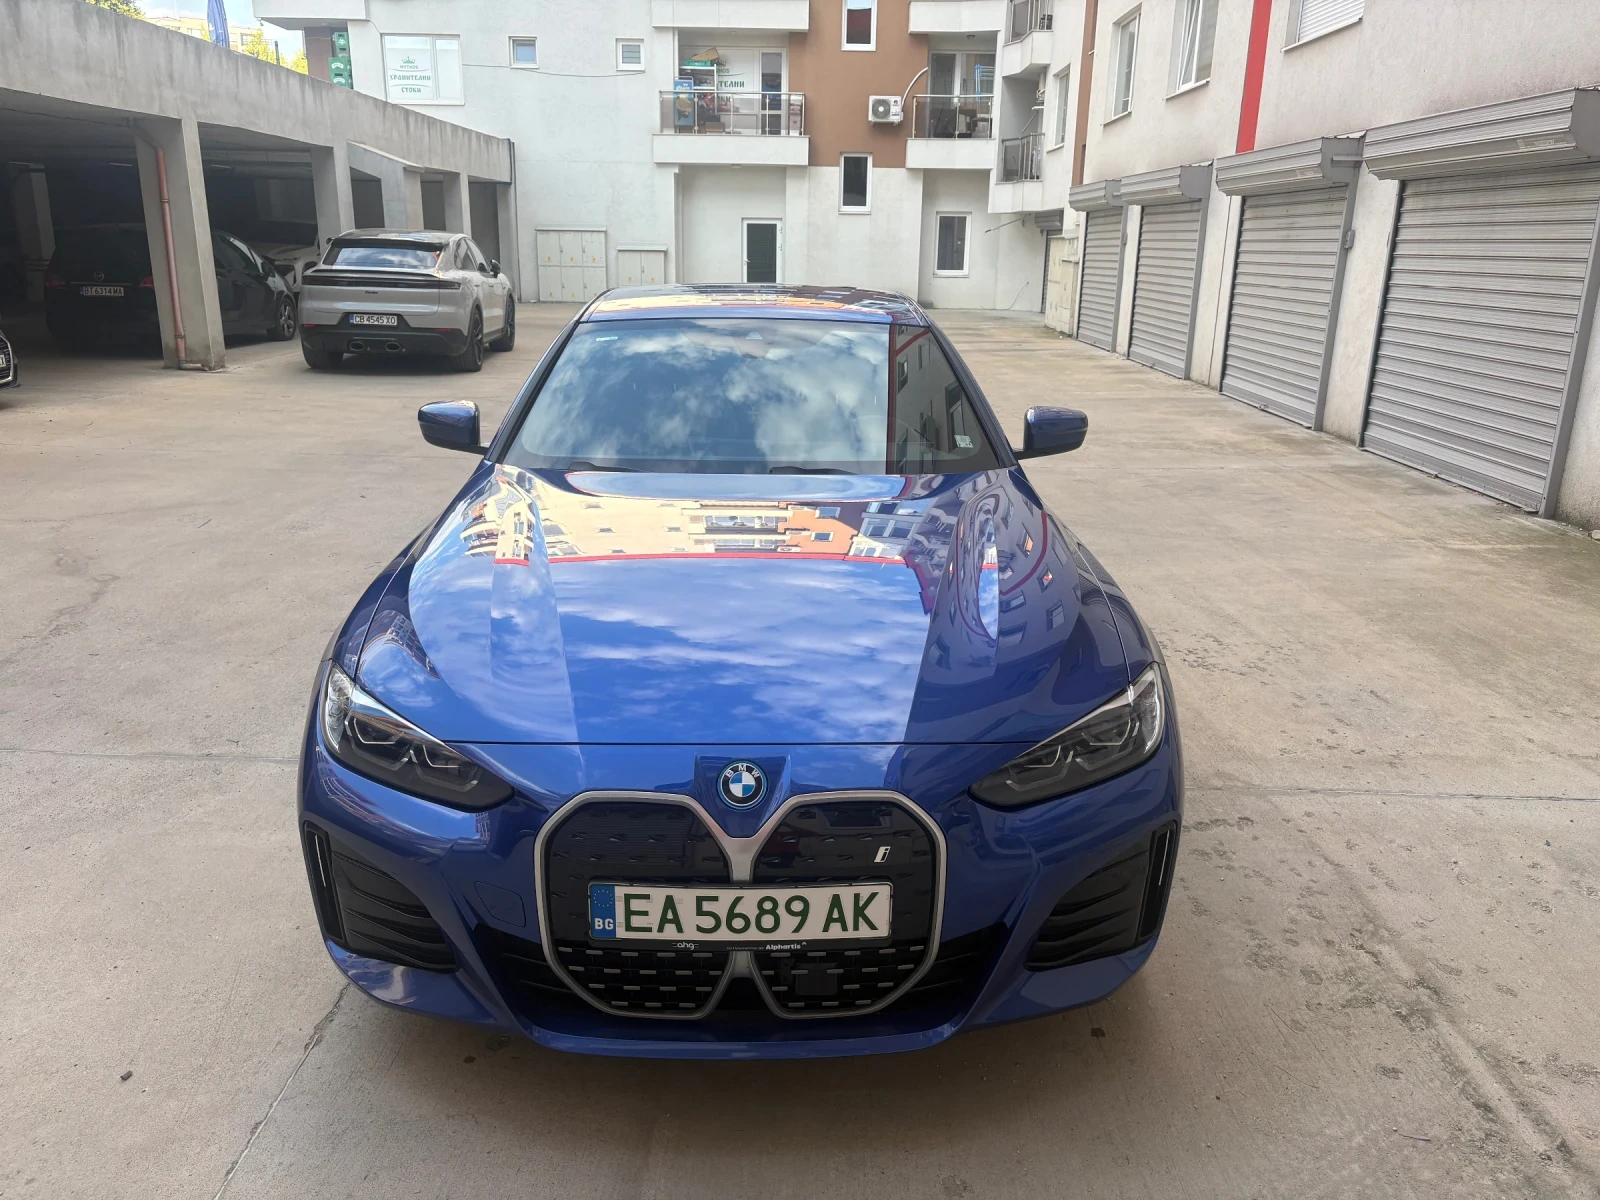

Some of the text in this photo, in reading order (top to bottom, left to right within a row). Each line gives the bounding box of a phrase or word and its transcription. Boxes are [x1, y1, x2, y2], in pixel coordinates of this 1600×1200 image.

[718, 80, 745, 88] ТЕЛНИ
[95, 287, 112, 295] 6314
[113, 287, 123, 296] MA
[354, 315, 396, 325] CB 4545 XO
[725, 764, 760, 778] BMW
[624, 891, 879, 934] EA 5689 AK
[594, 918, 614, 930] BG
[676, 942, 695, 950] ahg
